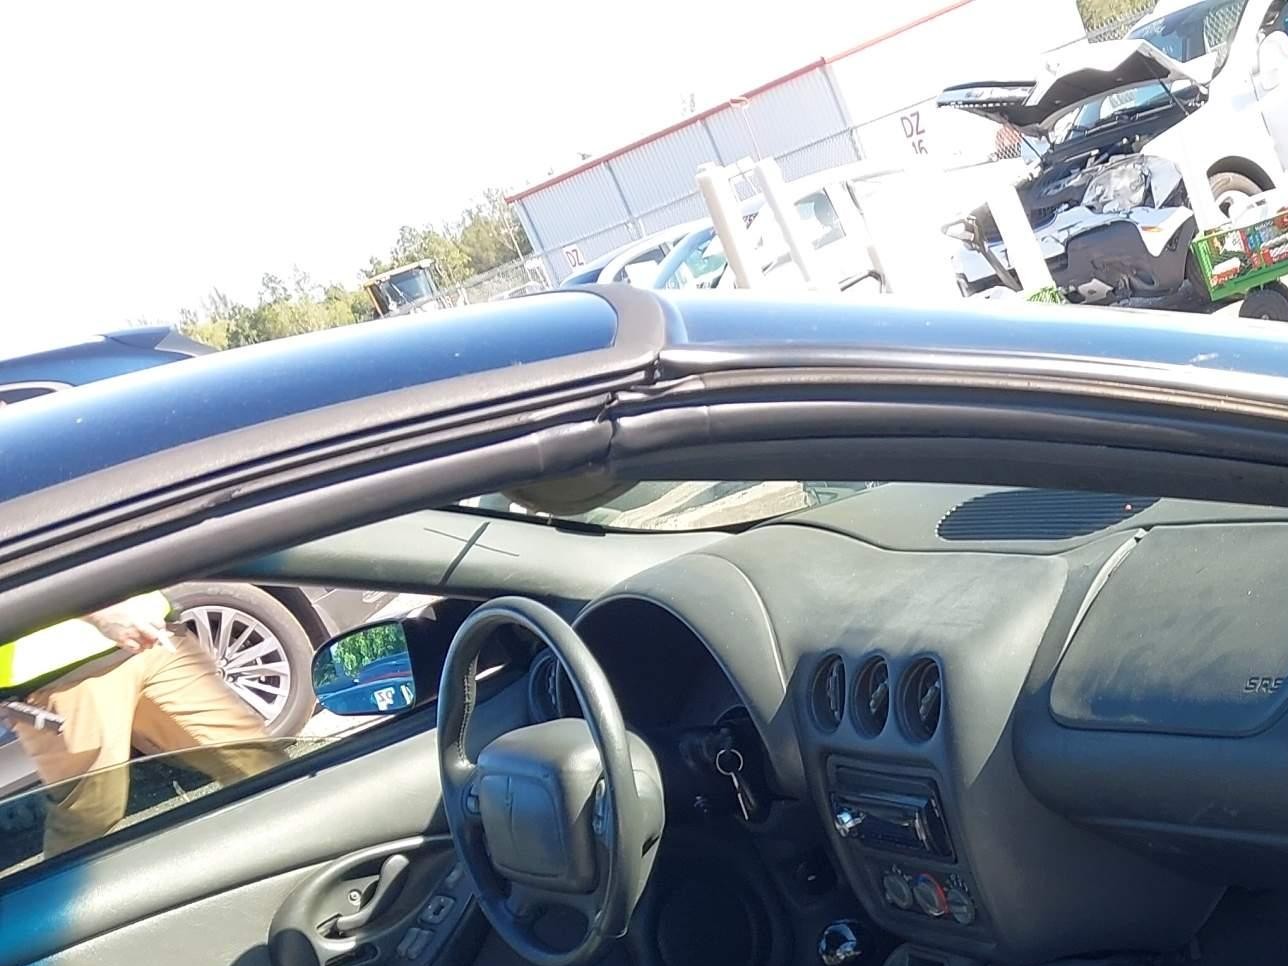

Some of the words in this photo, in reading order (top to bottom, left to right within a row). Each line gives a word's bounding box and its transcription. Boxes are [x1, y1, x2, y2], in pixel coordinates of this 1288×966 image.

[900, 111, 926, 139] DZ
[565, 249, 585, 268] DZ
[1242, 675, 1284, 694] SRS
